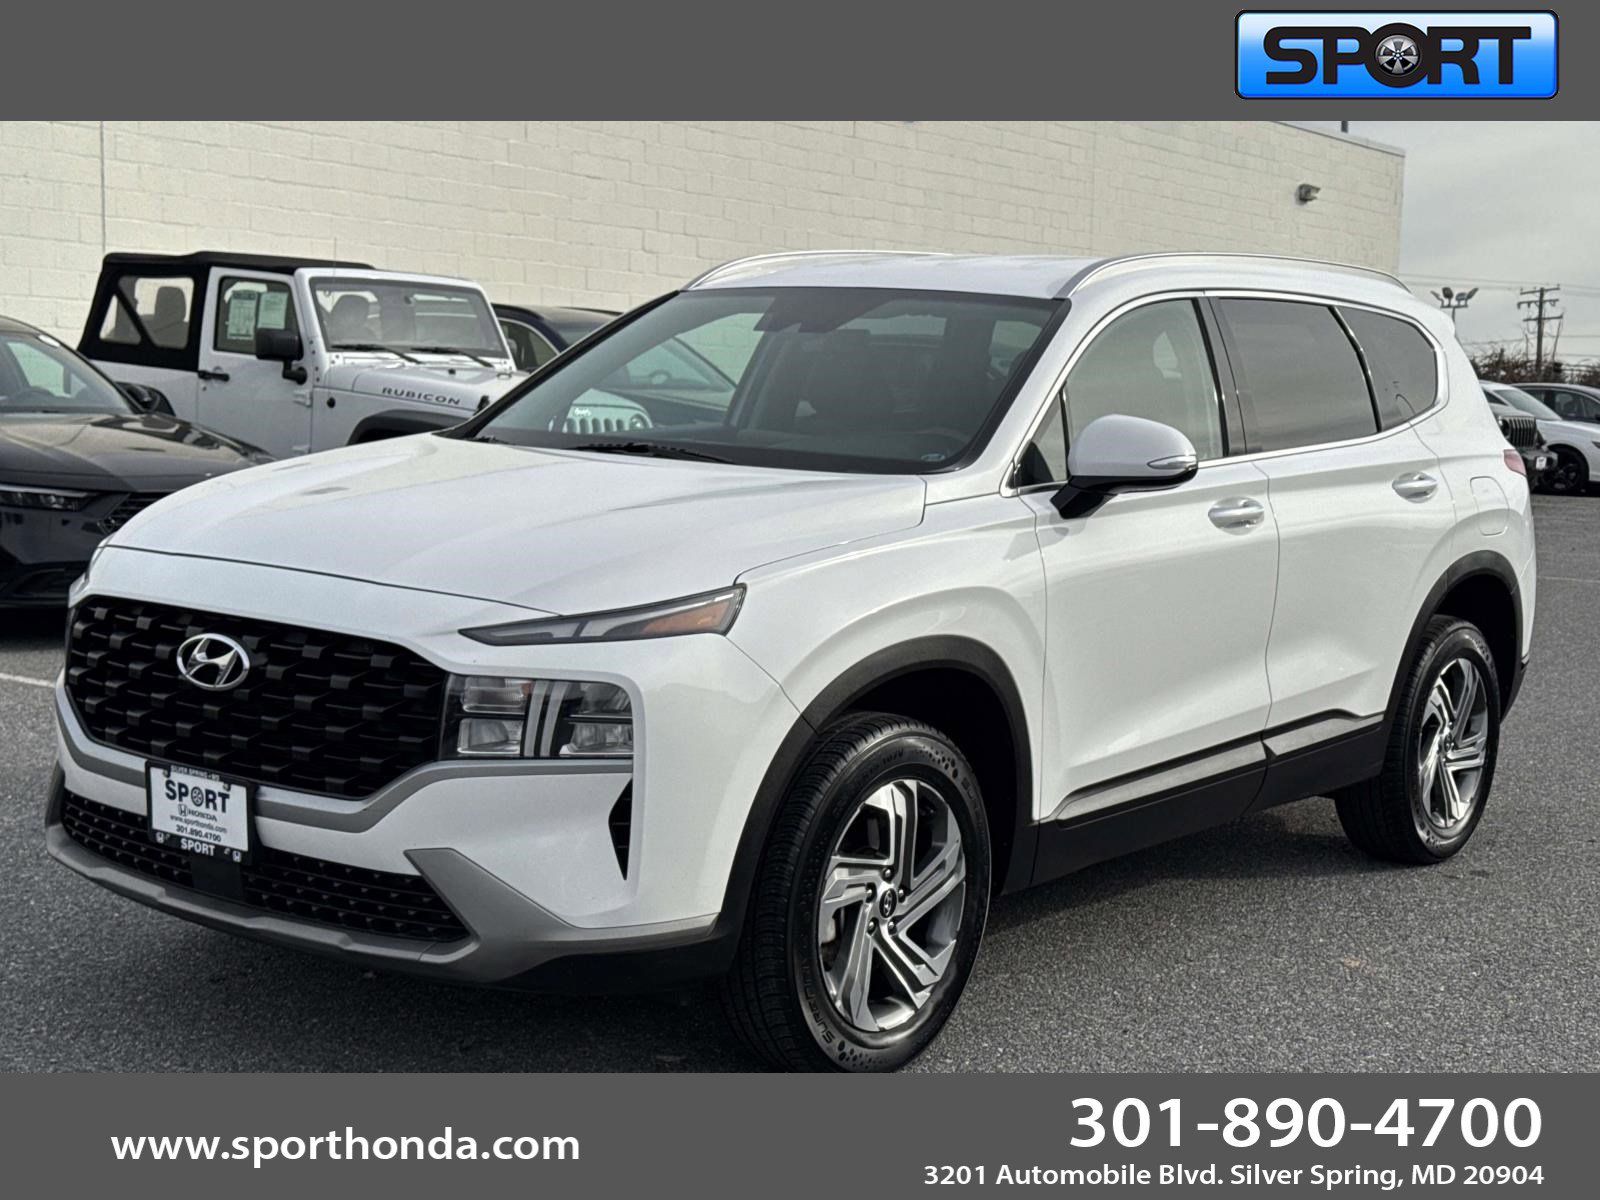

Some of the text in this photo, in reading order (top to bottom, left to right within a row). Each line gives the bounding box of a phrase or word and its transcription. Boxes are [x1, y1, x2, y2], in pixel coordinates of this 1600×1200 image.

[382, 387, 461, 405] RUBICON
[165, 779, 230, 813] SPORT
[188, 808, 218, 822] HONDA
[176, 824, 222, 842] 301.890.4700
[180, 838, 216, 856] SPORT
